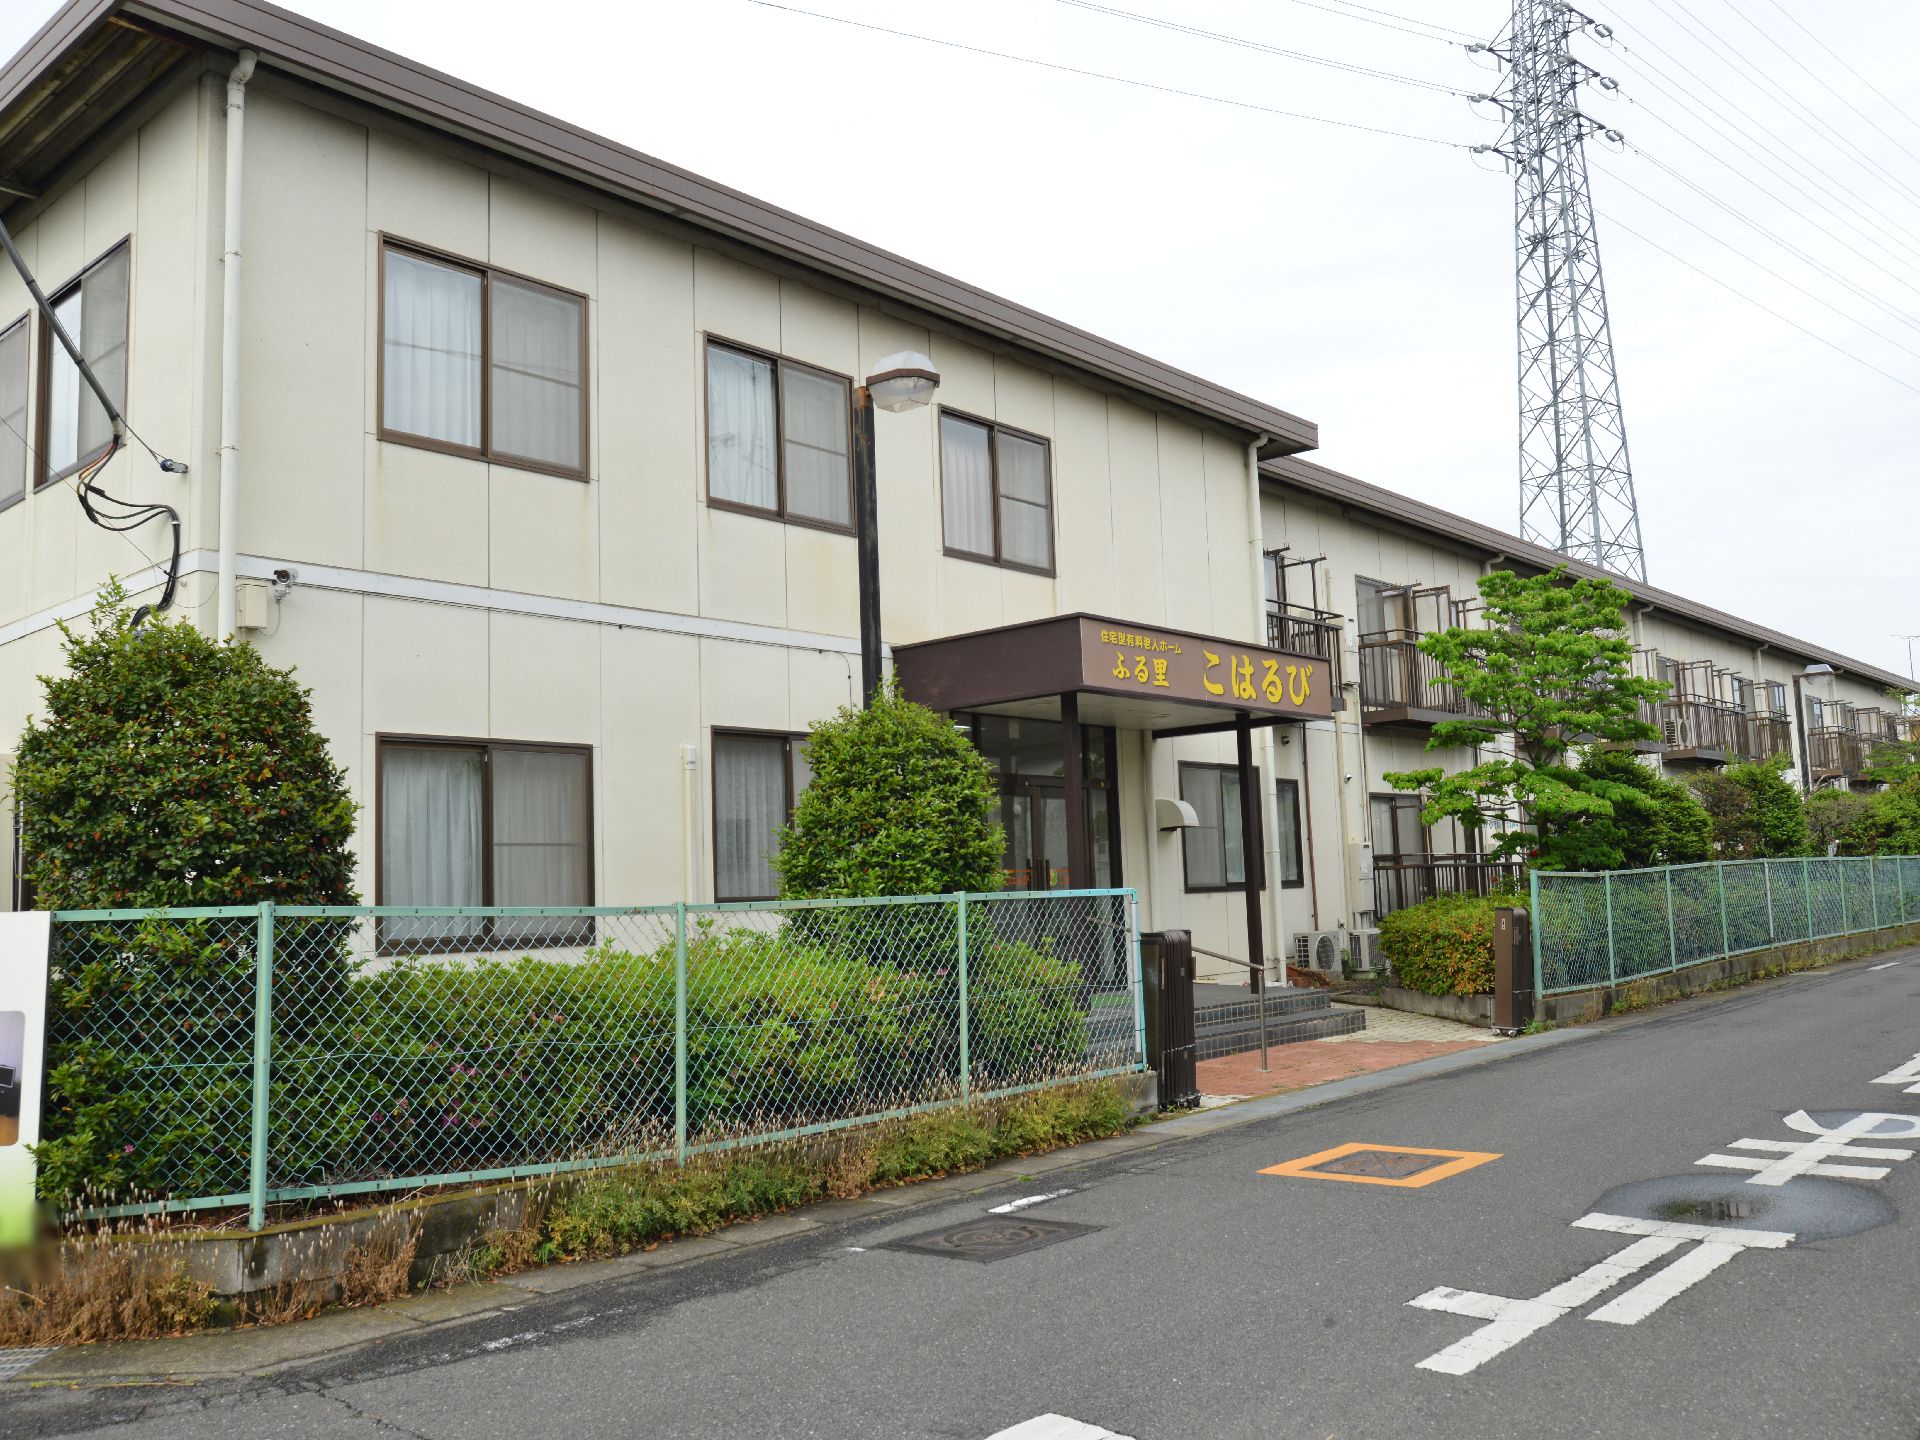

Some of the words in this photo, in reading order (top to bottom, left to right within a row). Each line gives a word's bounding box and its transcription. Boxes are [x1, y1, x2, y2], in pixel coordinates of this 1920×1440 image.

[1101, 628, 1182, 654] 住宅型有料老人ホーム
[1112, 652, 1170, 687] ふる里
[1203, 650, 1313, 706] こはるび
[1403, 1052, 1920, 1376] 止ま
